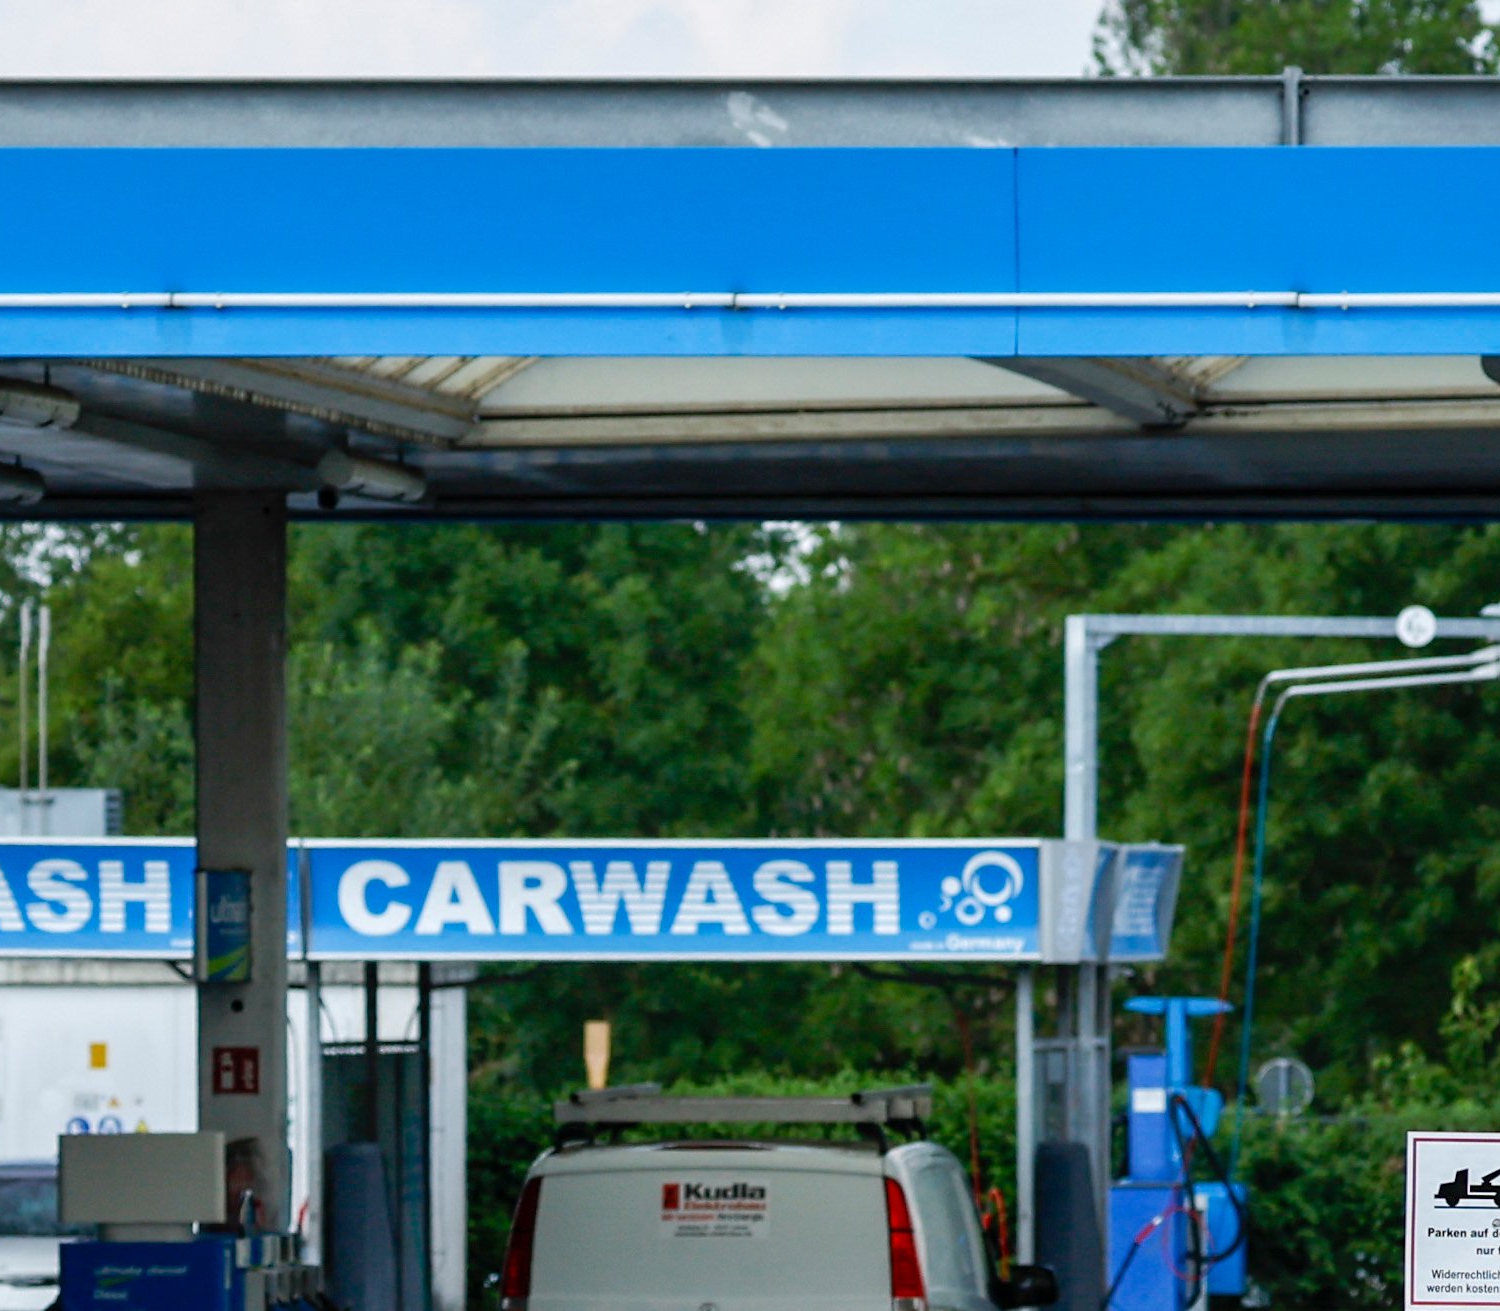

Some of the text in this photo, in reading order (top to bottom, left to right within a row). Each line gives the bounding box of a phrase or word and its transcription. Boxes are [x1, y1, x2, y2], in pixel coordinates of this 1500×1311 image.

[337, 859, 900, 936] CARWASH
[684, 1182, 767, 1199] Kudla
[1427, 1227, 1467, 1238] Parken
[1470, 1228, 1489, 1238] auf
[1476, 1247, 1494, 1255] nur
[1426, 1284, 1463, 1293] werden
